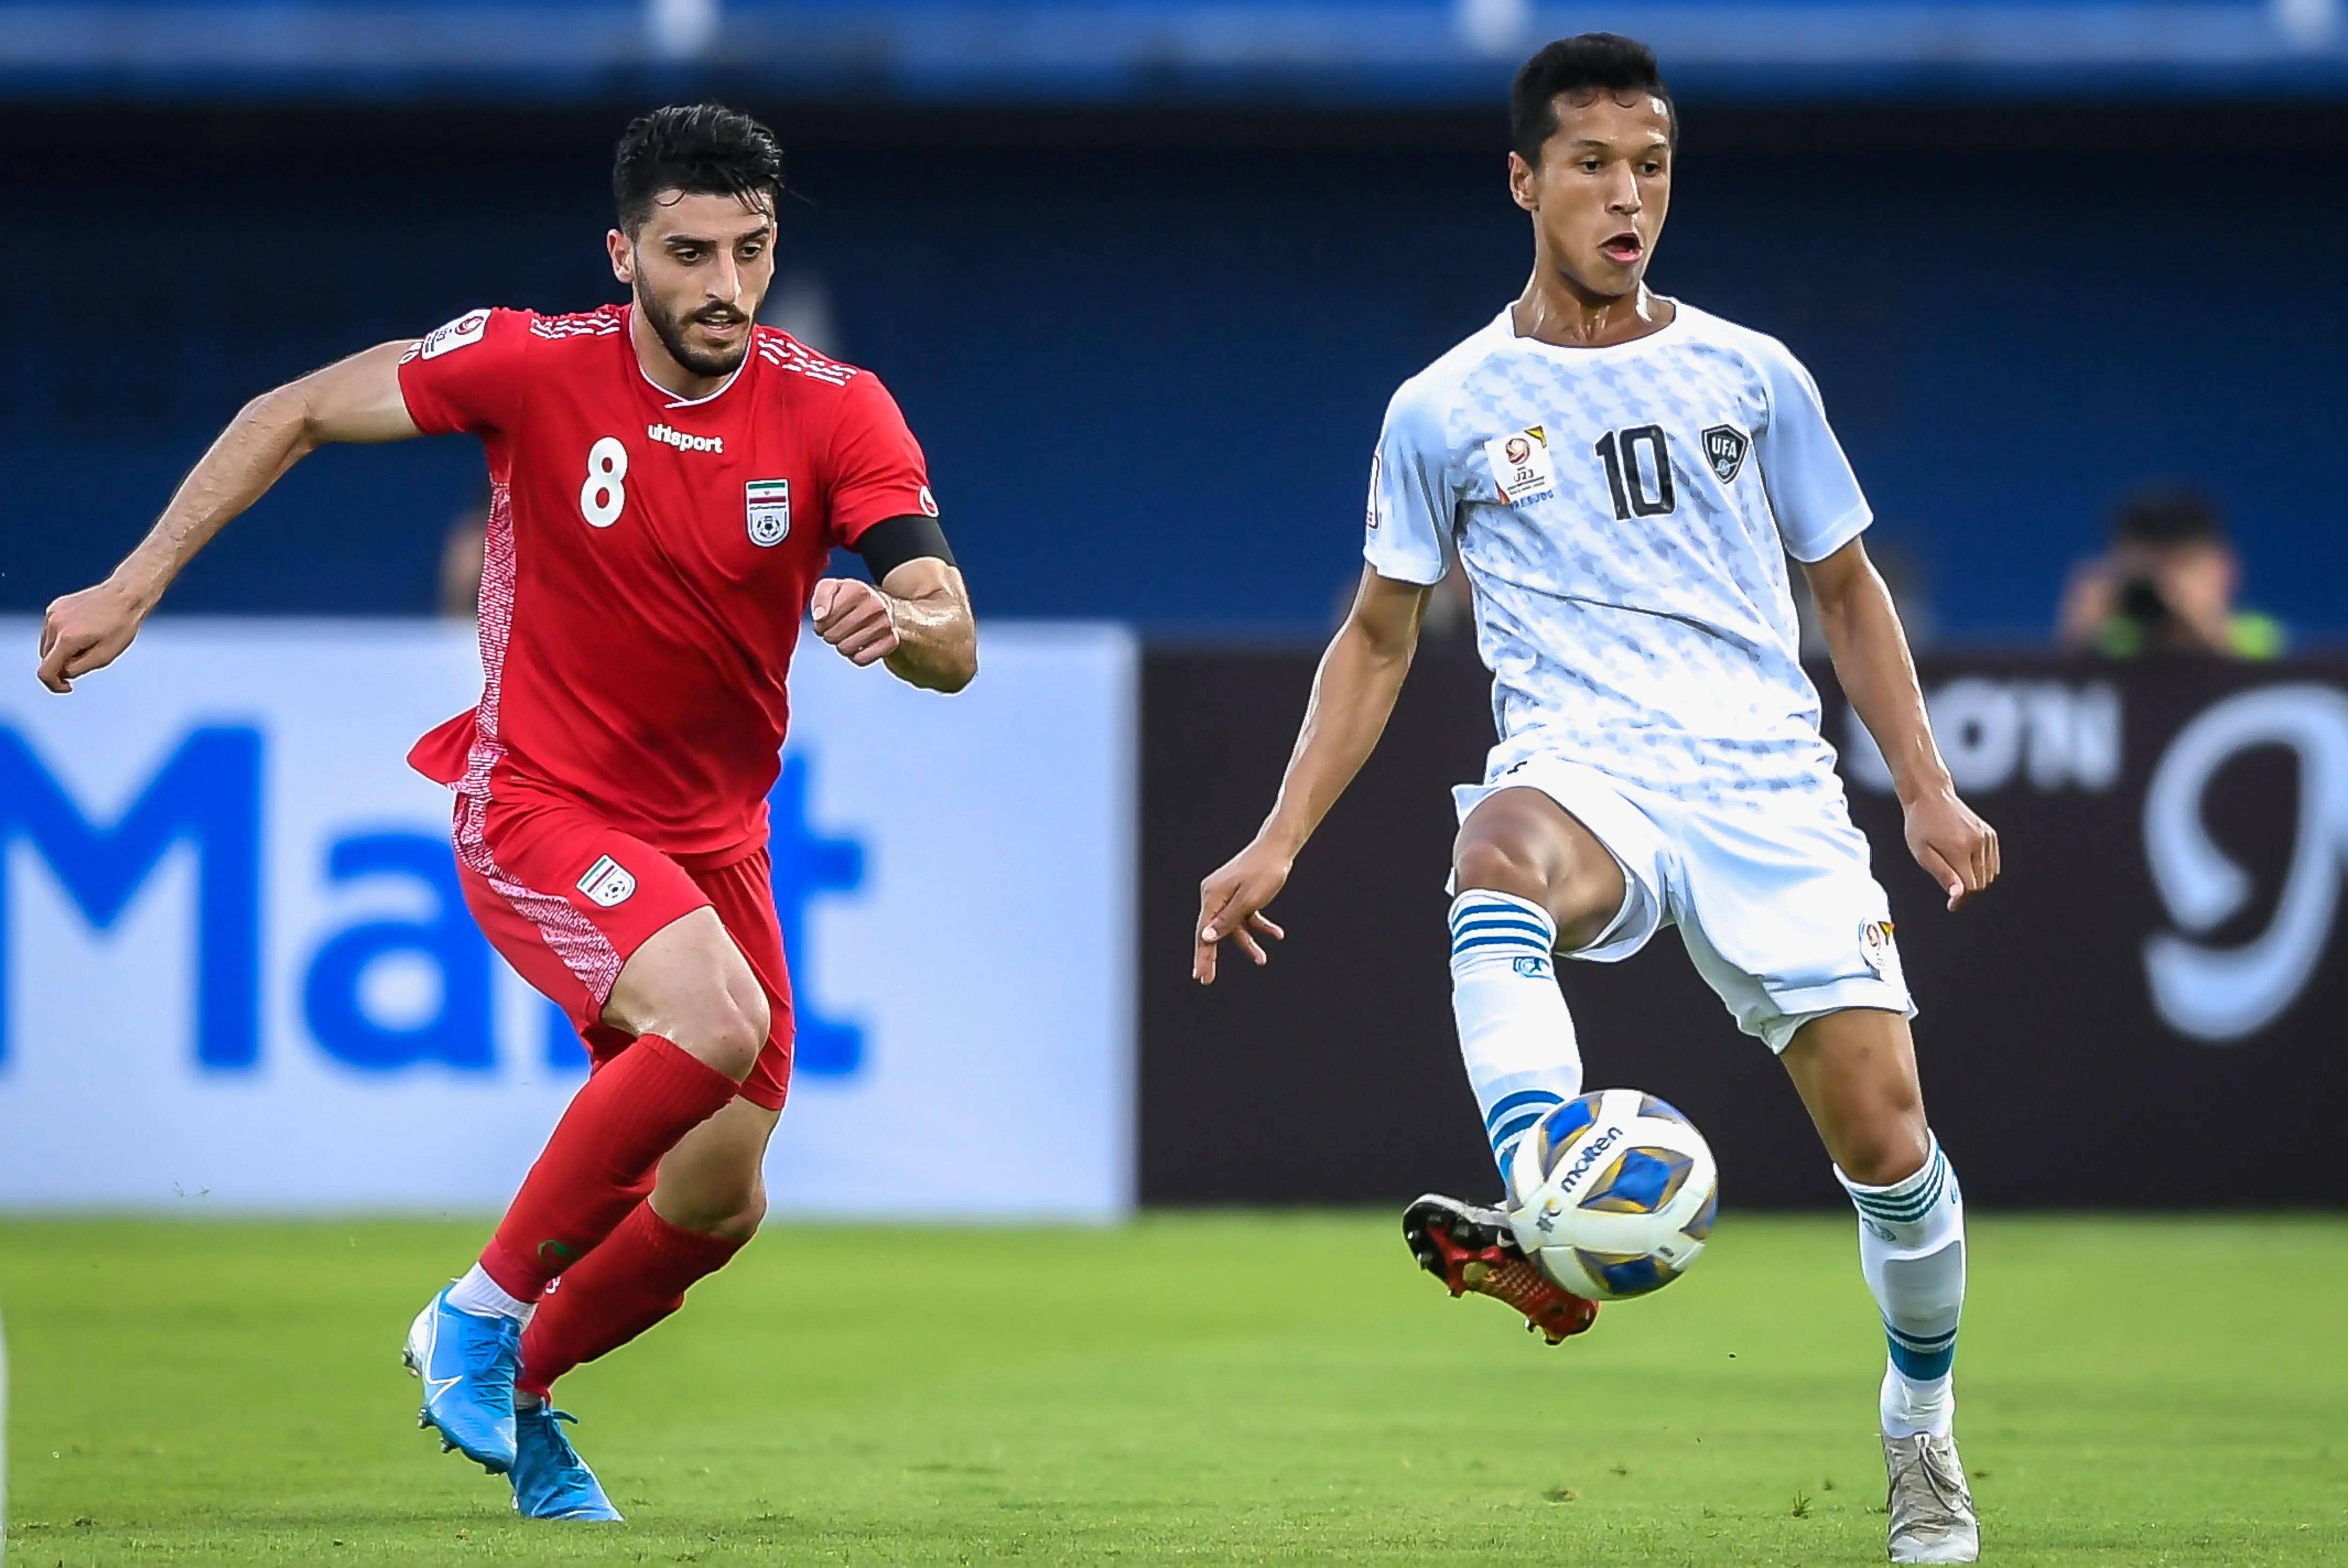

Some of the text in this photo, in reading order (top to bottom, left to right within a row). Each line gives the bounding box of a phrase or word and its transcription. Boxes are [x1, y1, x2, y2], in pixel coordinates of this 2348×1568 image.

[648, 423, 724, 454] uhlsport
[1712, 436, 1737, 459] UFA
[580, 436, 628, 528] 8
[1595, 424, 1675, 520] 10
[1561, 1127, 1623, 1193] molten
